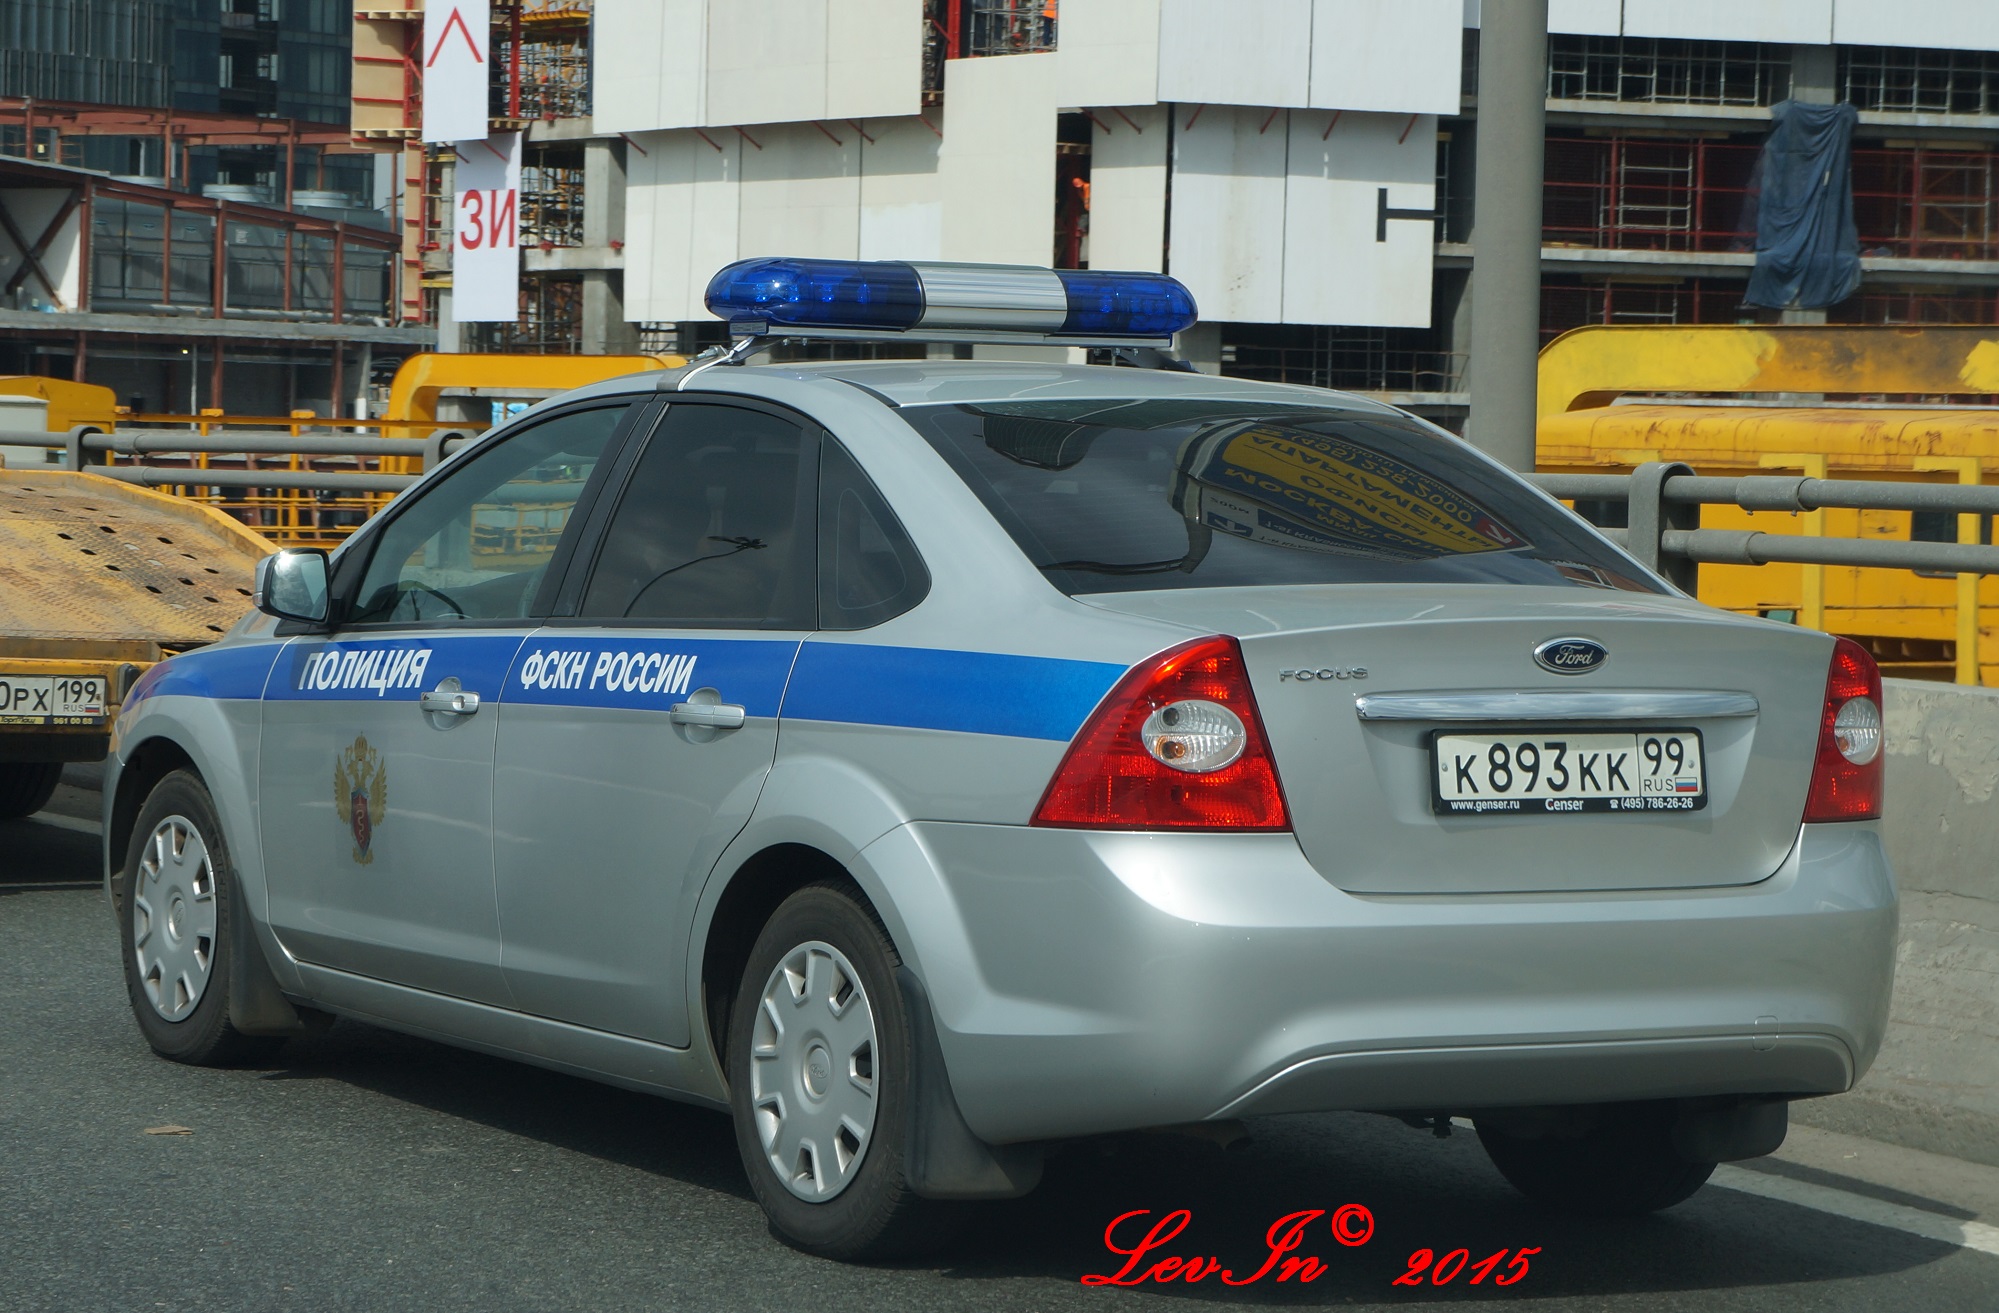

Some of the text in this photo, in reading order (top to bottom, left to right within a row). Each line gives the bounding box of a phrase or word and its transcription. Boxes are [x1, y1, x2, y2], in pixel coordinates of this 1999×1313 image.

[1555, 646, 1593, 664] Ford
[298, 649, 432, 697] ПОЛИЦИЯ
[520, 649, 698, 695] ФСКН РОССИИ
[1279, 666, 1368, 682] FOCUS
[57, 680, 97, 703] 199
[63, 704, 84, 712] RUS
[1643, 737, 1684, 776] 99
[1643, 779, 1673, 792] RUS
[1450, 797, 1694, 811] www.genser.ru Genser (495) 786-26-26
